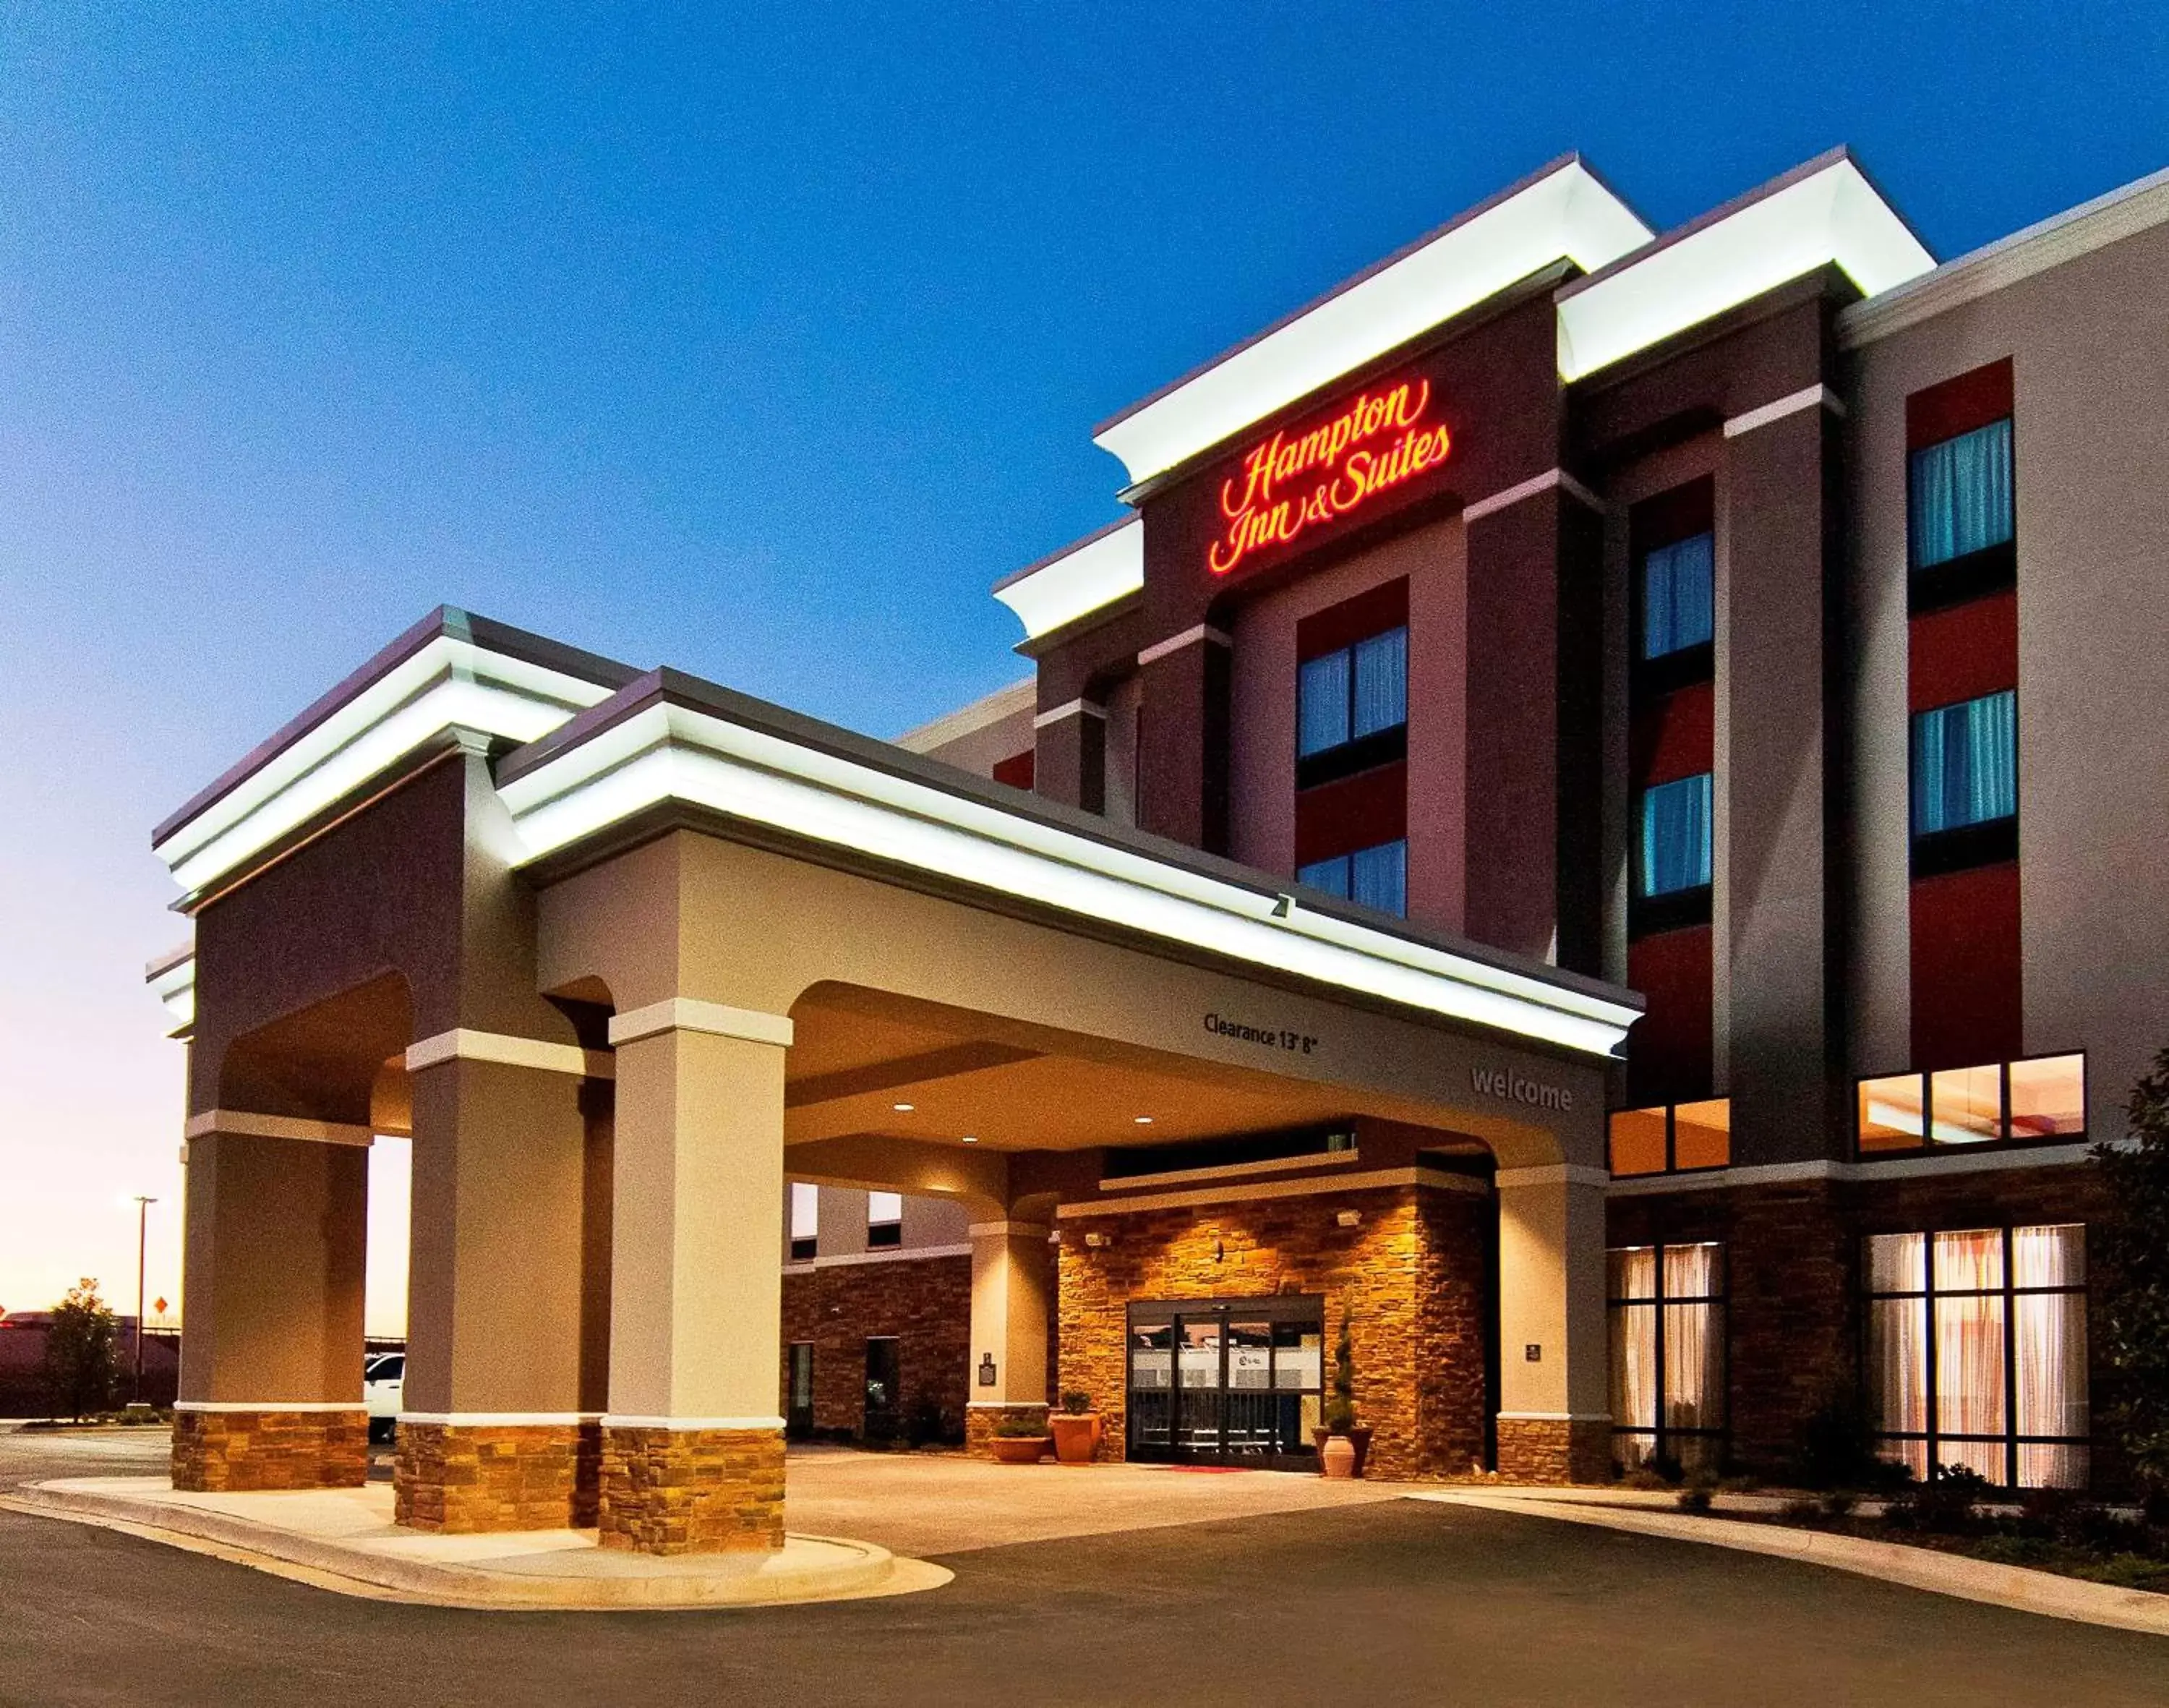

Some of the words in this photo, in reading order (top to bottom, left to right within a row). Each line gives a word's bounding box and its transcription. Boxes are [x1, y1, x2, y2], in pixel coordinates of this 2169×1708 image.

[1210, 497, 1306, 572] Inn
[1306, 484, 1334, 523] &
[1330, 424, 1450, 511] Suites
[1223, 379, 1429, 517] Hampton
[1204, 1013, 1276, 1046] Clearance
